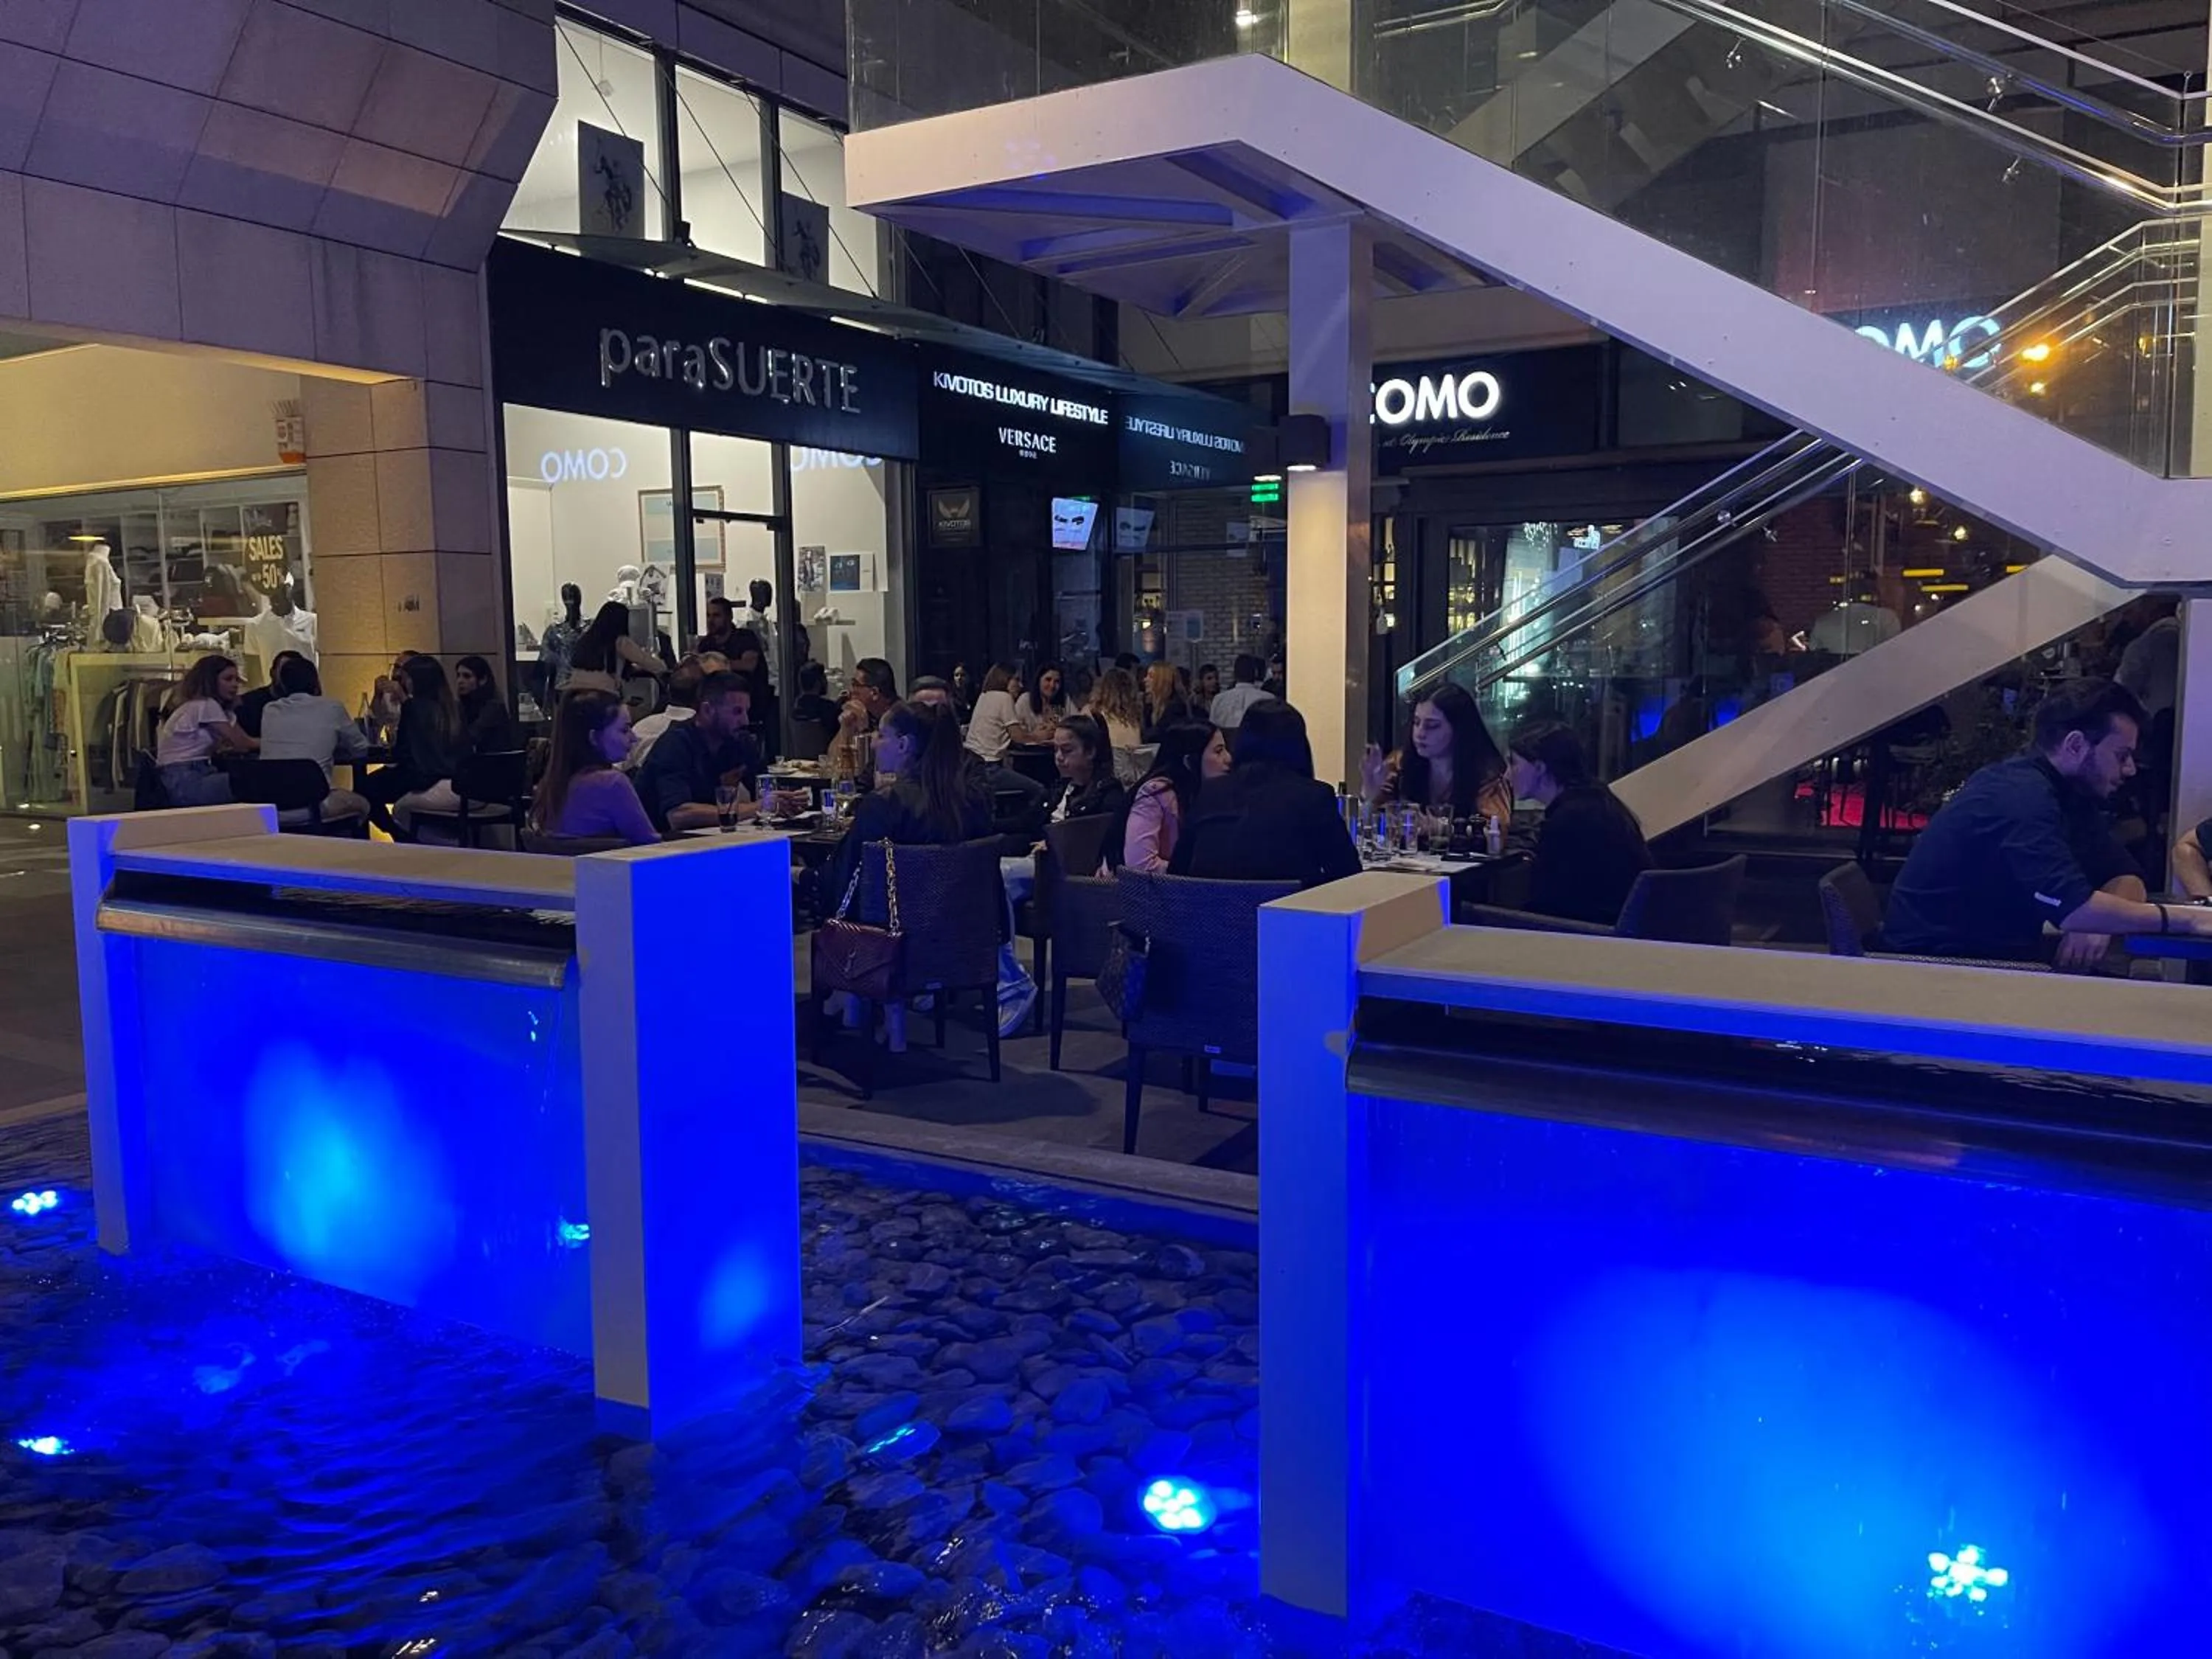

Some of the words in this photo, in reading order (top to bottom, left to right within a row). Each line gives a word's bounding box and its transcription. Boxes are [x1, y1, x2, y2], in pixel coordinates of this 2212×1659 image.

[599, 327, 861, 413] paraSUERTE
[933, 371, 994, 400] KIVOTOS
[995, 384, 1049, 411] LUXURY
[1050, 397, 1109, 425] LIFESTYLE
[998, 426, 1057, 453] VERSACE
[248, 535, 283, 560] SALES
